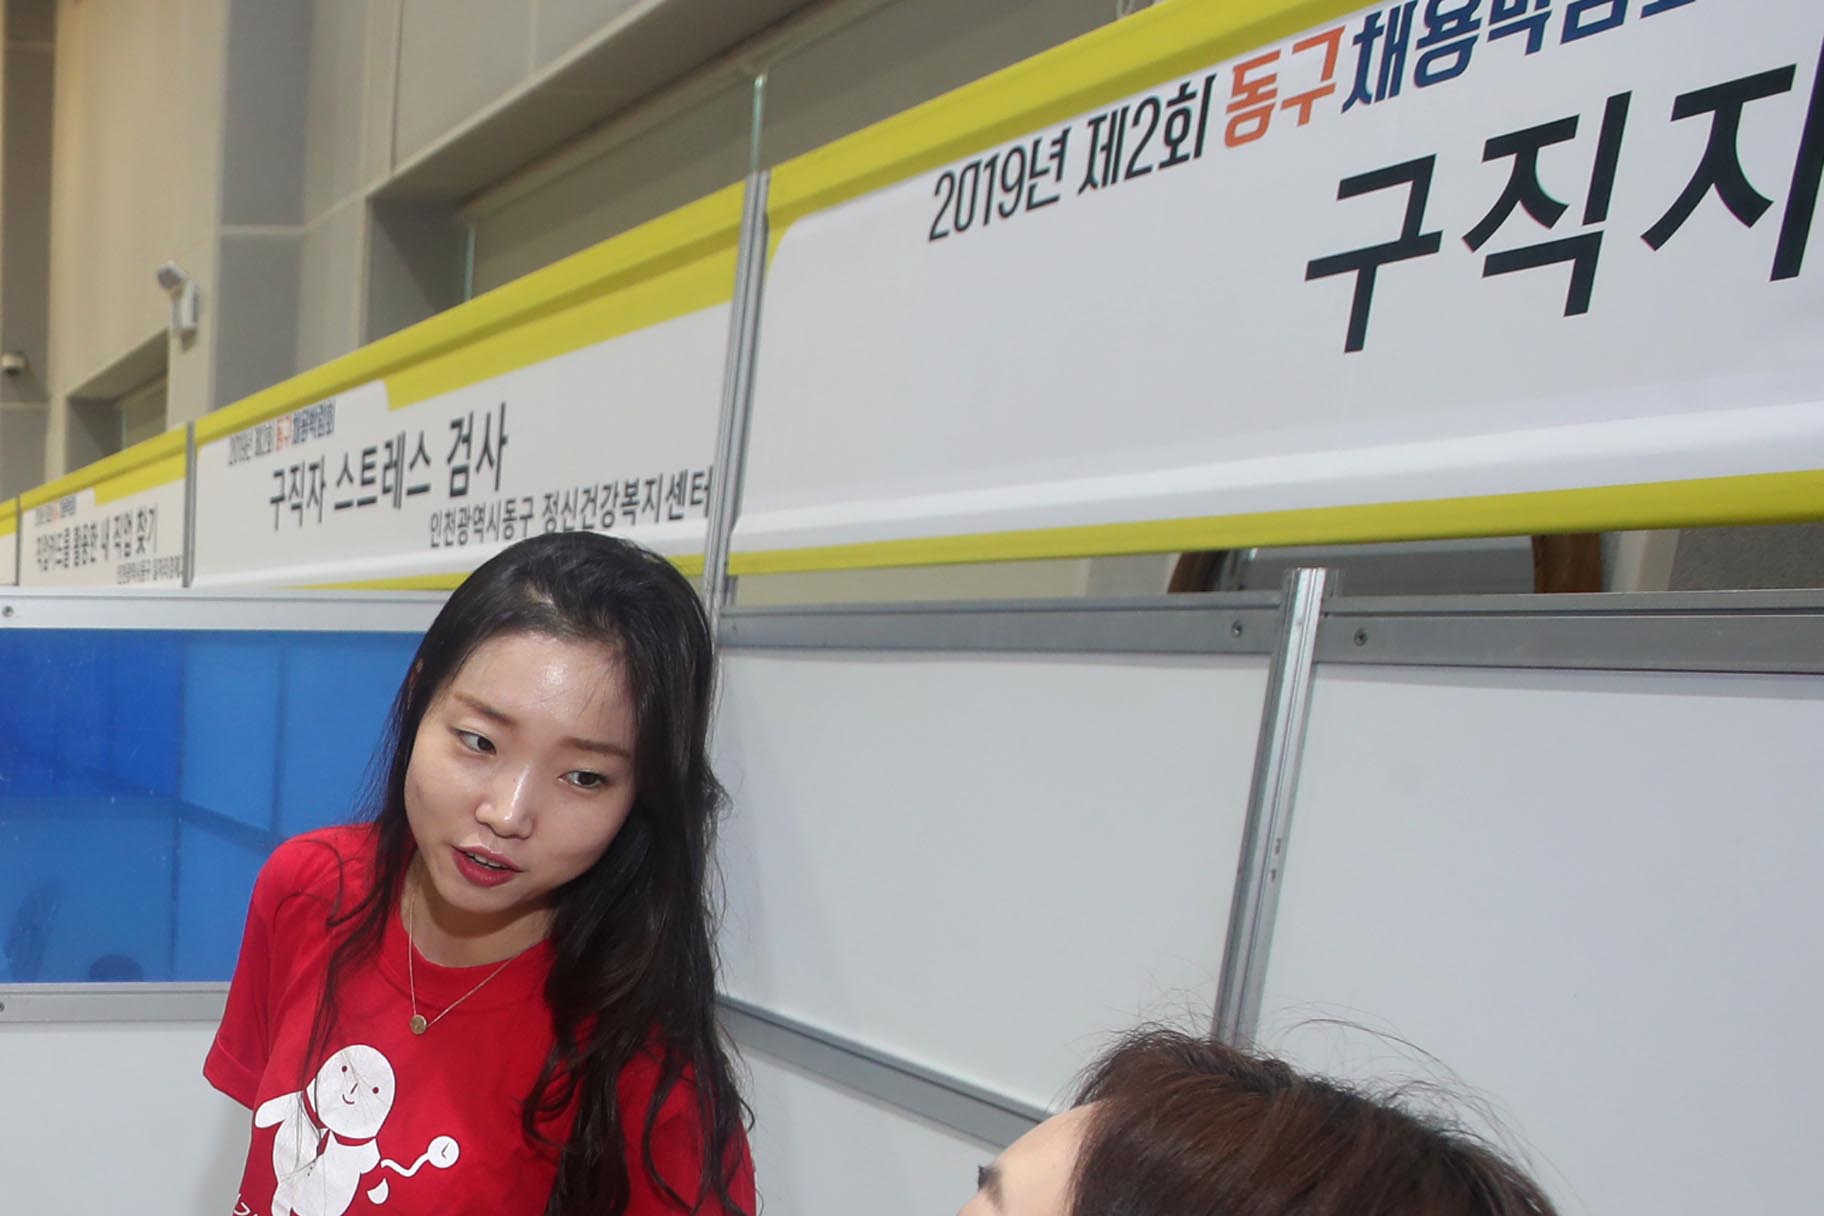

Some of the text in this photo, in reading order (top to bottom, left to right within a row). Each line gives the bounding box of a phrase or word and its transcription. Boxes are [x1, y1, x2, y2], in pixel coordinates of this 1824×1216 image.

[928, 126, 1071, 242] 2019년
[1077, 74, 1219, 195] 제2회
[270, 401, 509, 533] 구직자 스트레스 검사
[542, 464, 713, 535] 정신건강복지센터
